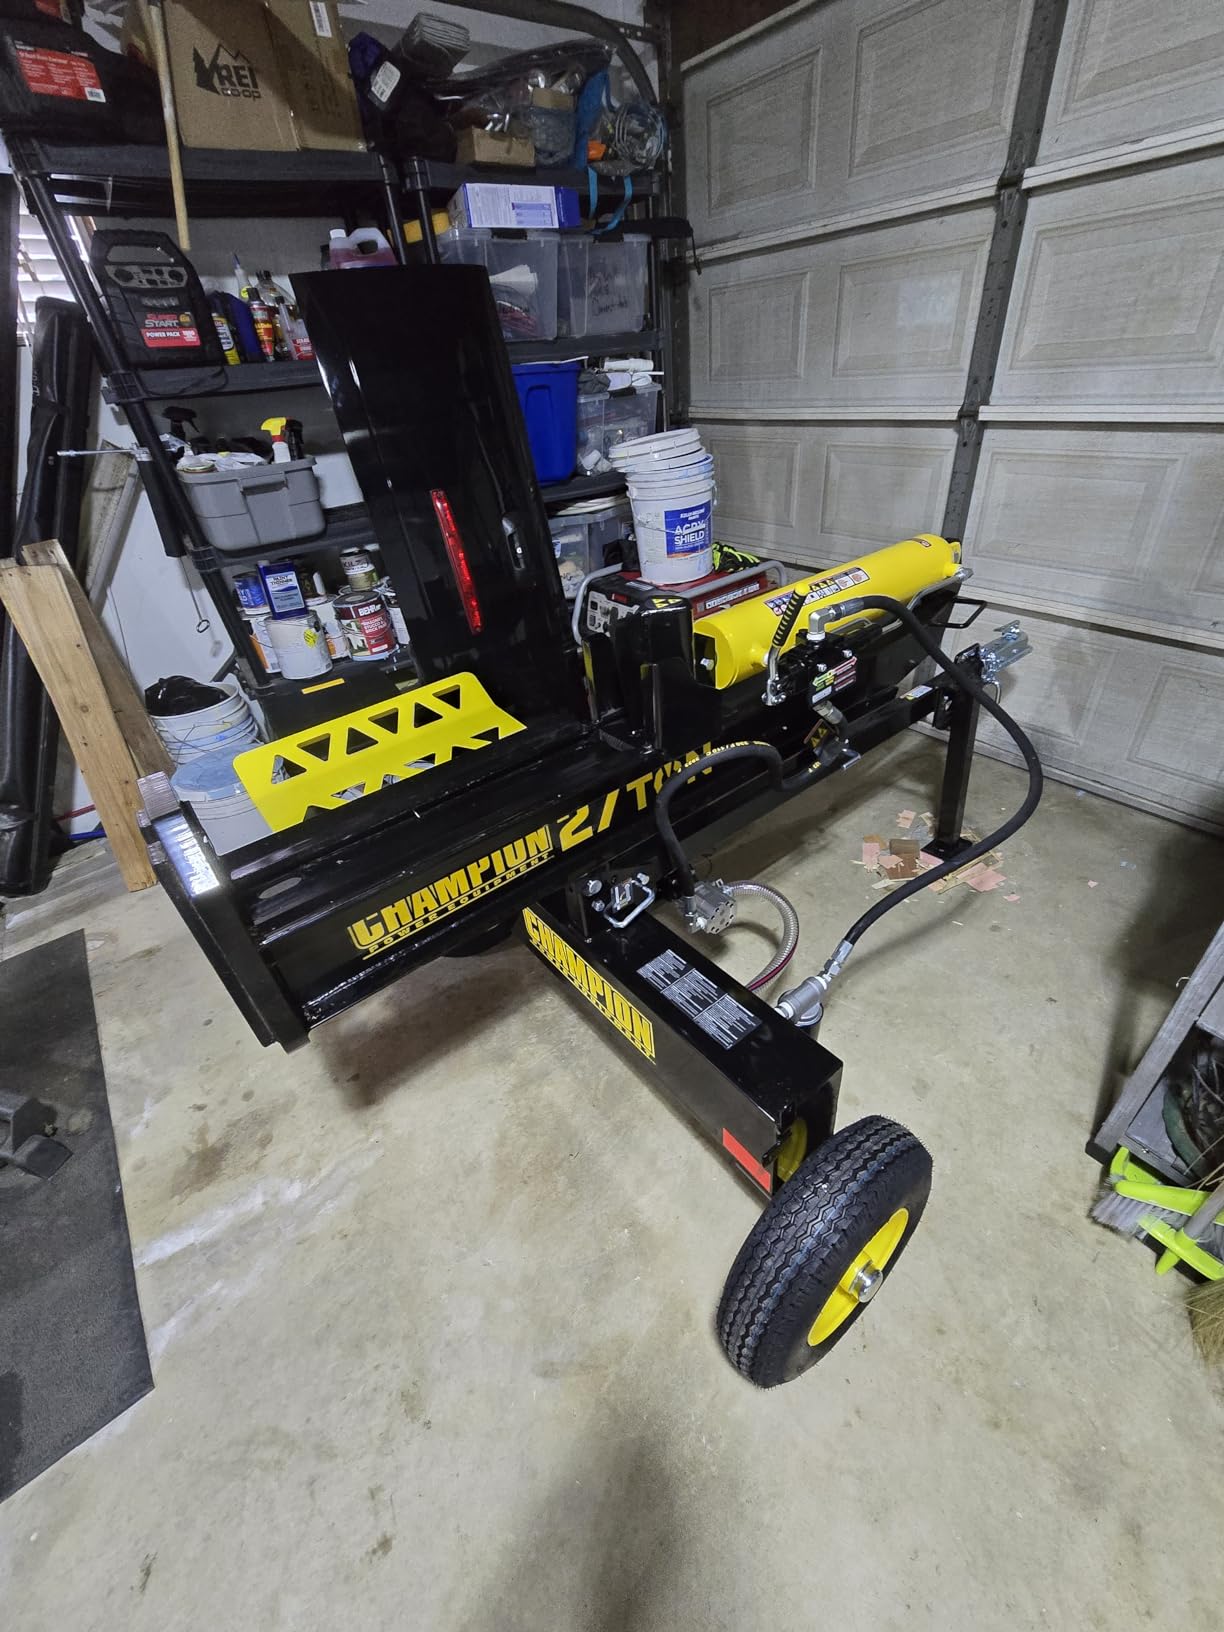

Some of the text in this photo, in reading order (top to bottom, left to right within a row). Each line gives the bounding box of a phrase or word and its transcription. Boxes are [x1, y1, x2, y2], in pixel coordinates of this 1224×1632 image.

[218, 64, 259, 89] REI
[145, 319, 179, 328] START
[674, 531, 704, 546] SHIELD
[358, 604, 376, 616] BEHR
[350, 826, 552, 947] CHAMPION
[368, 852, 550, 953] POWER EQUIPMENT
[523, 908, 655, 1057] CHAMPION
